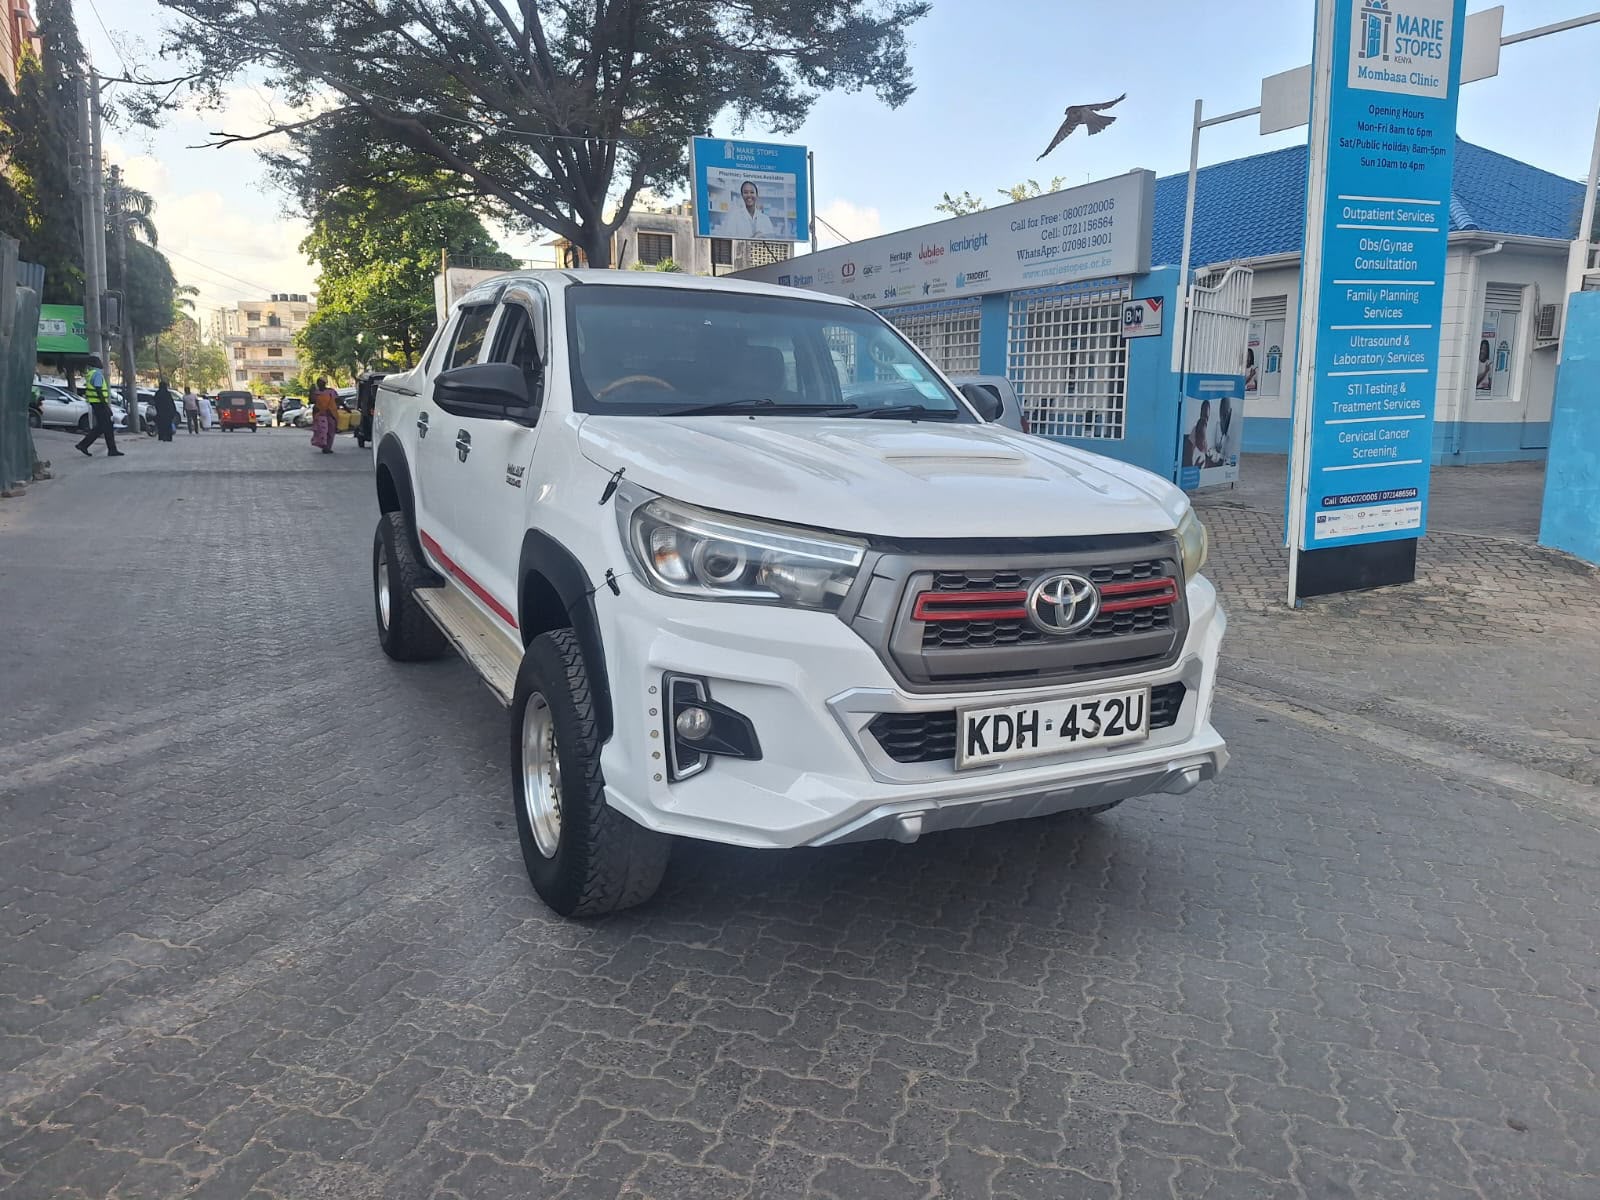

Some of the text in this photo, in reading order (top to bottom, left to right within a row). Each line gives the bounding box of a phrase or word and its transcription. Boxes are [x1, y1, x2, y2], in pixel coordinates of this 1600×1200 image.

[1396, 14, 1444, 40] MARIE
[1395, 37, 1442, 60] STOPES
[1358, 65, 1439, 87] Mombasa Clinic
[1369, 105, 1424, 119] Opening Hours
[1358, 121, 1432, 138] Mon-Fri 8am to 6pm
[736, 147, 778, 156] MARIE STOPES
[1340, 138, 1446, 156] Sat/Public Holiday 8am-5pm
[1361, 157, 1425, 171] Sun 10am to 4pm
[1011, 199, 1114, 232] Call for Free: 0800720005
[1343, 207, 1435, 222] Outpatient Services
[1042, 229, 1060, 241] Cell:
[950, 233, 988, 253] kenbright
[1359, 238, 1413, 254] Obs/Gynae
[890, 251, 912, 262] Heritage
[1017, 245, 1060, 260] WhatsApp:
[1355, 257, 1417, 270] Consultation
[1347, 289, 1419, 304] Family Planning
[1364, 307, 1403, 318] Services
[1350, 335, 1410, 347] Ultrasound &
[1334, 351, 1424, 366] Laboratory Services
[1348, 382, 1406, 396] STI Testing &
[1332, 399, 1420, 413] Treatment Services
[1338, 429, 1410, 443] Cervical Cancer
[1353, 445, 1397, 458] Screening
[1324, 497, 1336, 505] Call
[968, 695, 1143, 756] KDH 432U
